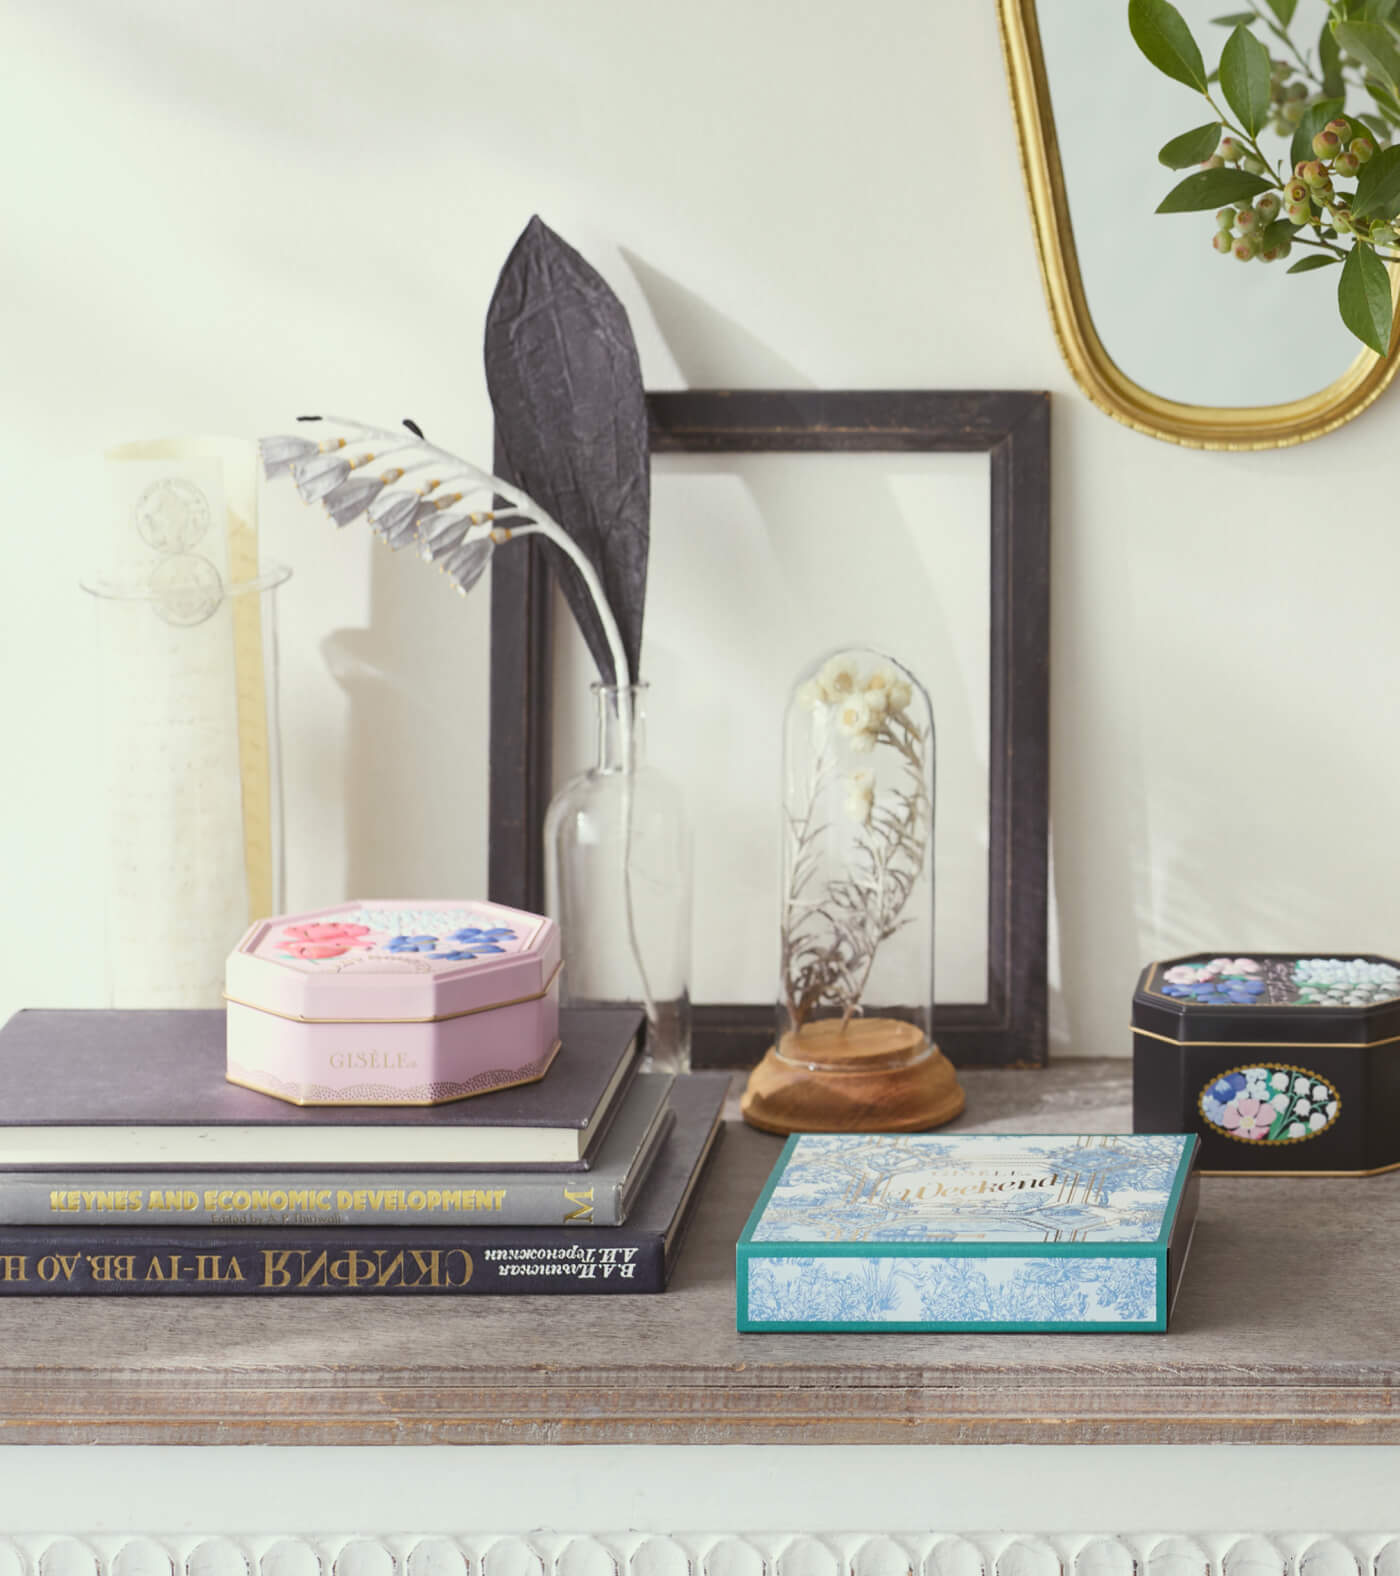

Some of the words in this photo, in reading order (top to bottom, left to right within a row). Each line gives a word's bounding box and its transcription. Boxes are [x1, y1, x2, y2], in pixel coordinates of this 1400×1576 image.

[50, 1190, 143, 1212] KEYNES
[148, 1190, 200, 1212] AND
[204, 1190, 332, 1212] ECONOMIC
[337, 1190, 507, 1211] DEVELOPMENT
[37, 1252, 81, 1281] ДО
[258, 1249, 474, 1288] СКИФИЯ
